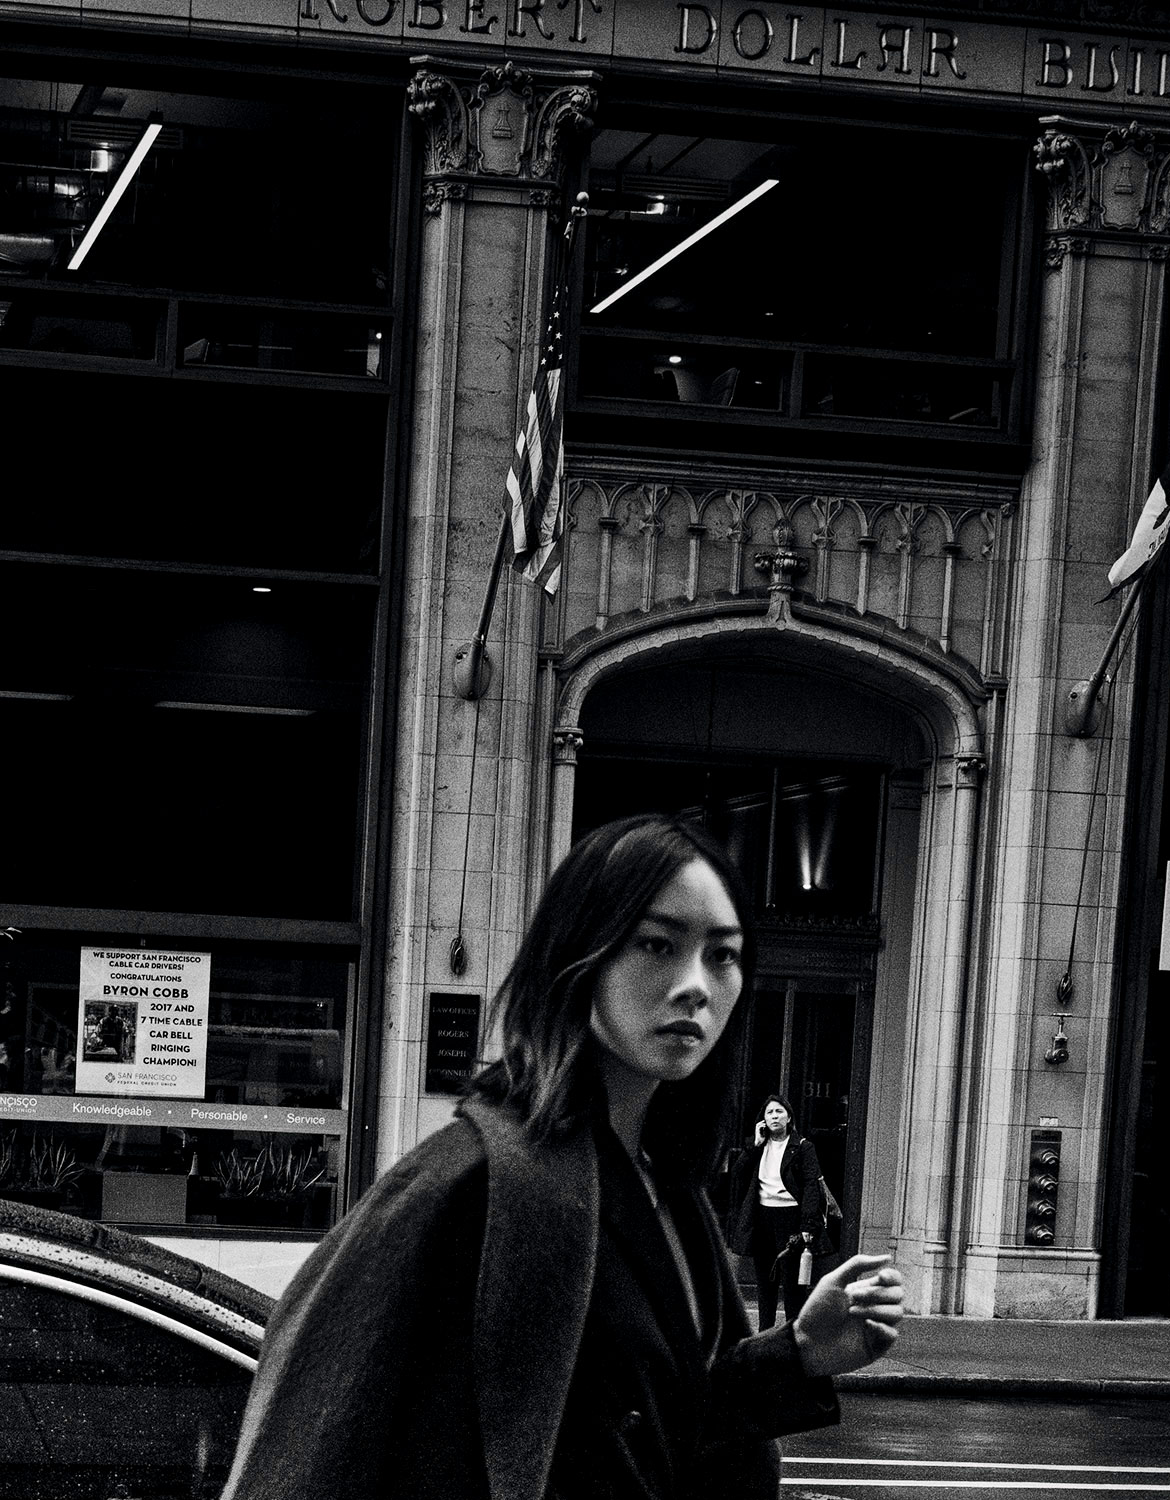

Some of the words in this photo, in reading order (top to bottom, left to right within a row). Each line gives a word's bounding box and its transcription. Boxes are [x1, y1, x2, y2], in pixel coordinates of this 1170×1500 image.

[674, 3, 967, 80] DOLLAR
[93, 951, 105, 959] WE
[106, 952, 141, 961] SUPPORT
[142, 953, 157, 961] SAN
[158, 955, 201, 963] FRANCISCO
[109, 960, 133, 968] CABLE
[151, 963, 185, 971] DRIVERS!
[110, 973, 182, 983] CONGRATULATIONS
[103, 985, 149, 996] BYRON
[153, 987, 189, 998] COBB
[150, 1003, 172, 1011] 2017
[174, 1004, 195, 1012] AND
[141, 1016, 147, 1024] 7
[148, 1017, 171, 1025] TIME
[172, 1018, 203, 1027] CABLE
[149, 1030, 169, 1039] CAR
[170, 1031, 193, 1040] BELL
[437, 1029, 469, 1038] ROGERS
[150, 1044, 191, 1053] RINGING
[438, 1049, 467, 1057] JOSEPH
[143, 1057, 197, 1067] CHAMPION!
[117, 1072, 133, 1080] SAN
[135, 1072, 178, 1082] FRANCISCO
[72, 1102, 152, 1118] Knowledgeable
[191, 1108, 248, 1121] Personable
[287, 1112, 326, 1125] Service
